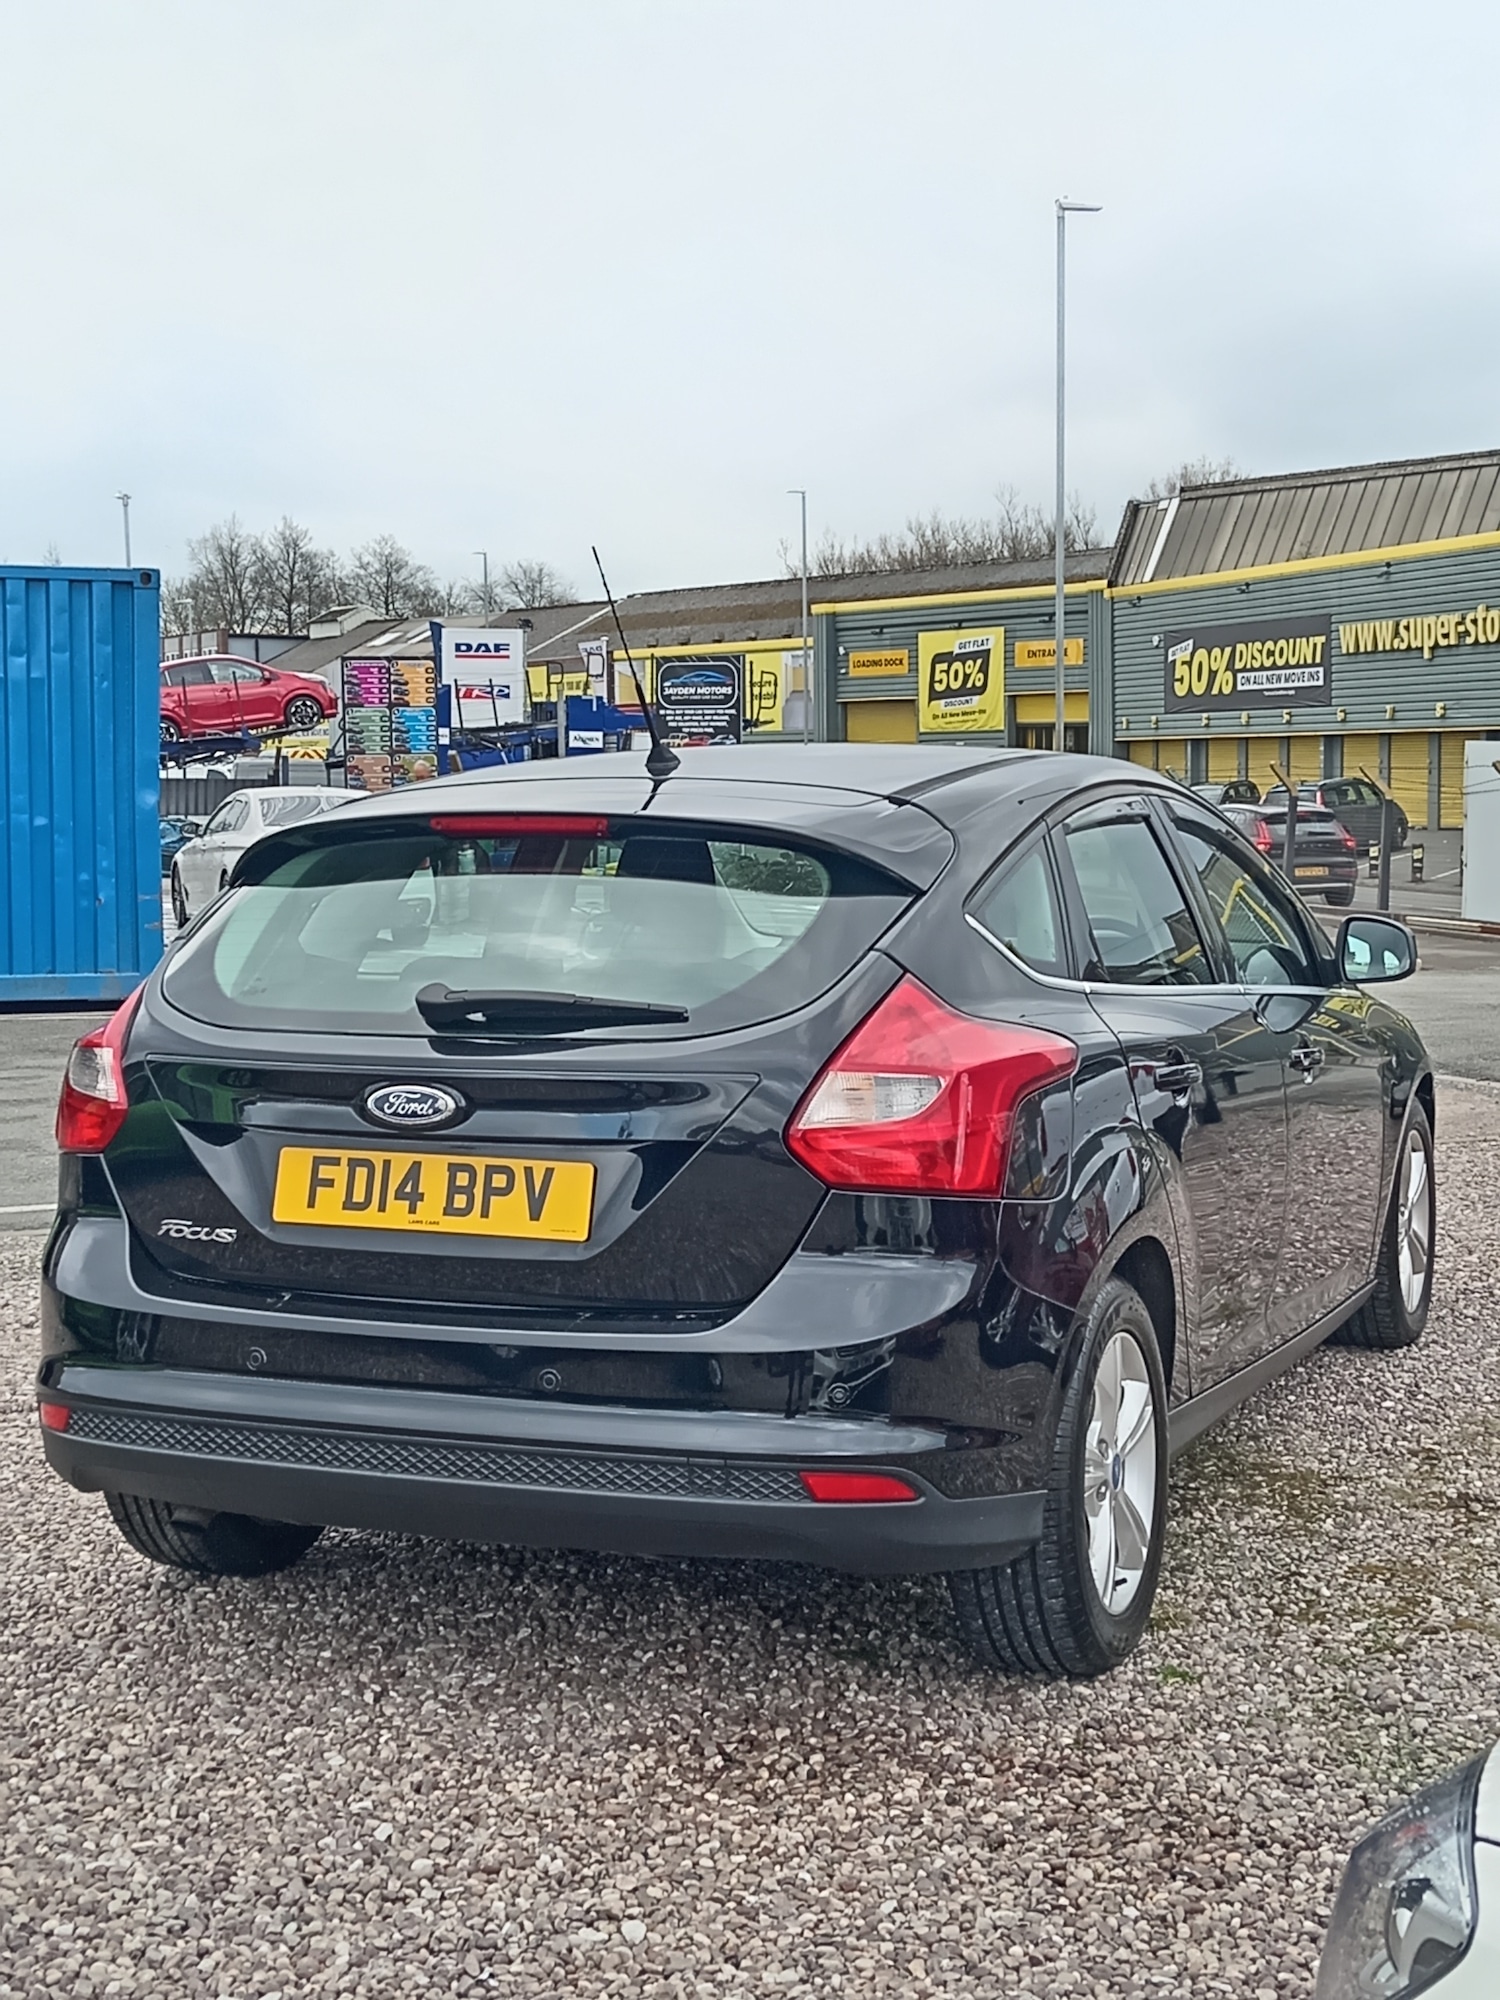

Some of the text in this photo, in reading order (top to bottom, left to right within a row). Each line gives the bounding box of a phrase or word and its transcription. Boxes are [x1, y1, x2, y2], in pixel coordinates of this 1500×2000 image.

[1339, 603, 1500, 660] www.super-sto
[455, 643, 510, 653] DAF
[958, 638, 990, 650] GET FLAT
[1234, 635, 1326, 669] DISCOUNT
[1027, 647, 1068, 659] ENTRANE
[852, 657, 904, 669] LOADING DOCK
[933, 658, 984, 692] 50%
[1174, 646, 1234, 697] 50%
[1240, 670, 1321, 686] ON ALL NEW MOVE INS
[663, 686, 733, 695] JAYDEN MOTORS
[944, 698, 973, 708] DISCOUNT
[384, 1092, 434, 1115] Ford
[306, 1155, 555, 1221] FD14 BPV
